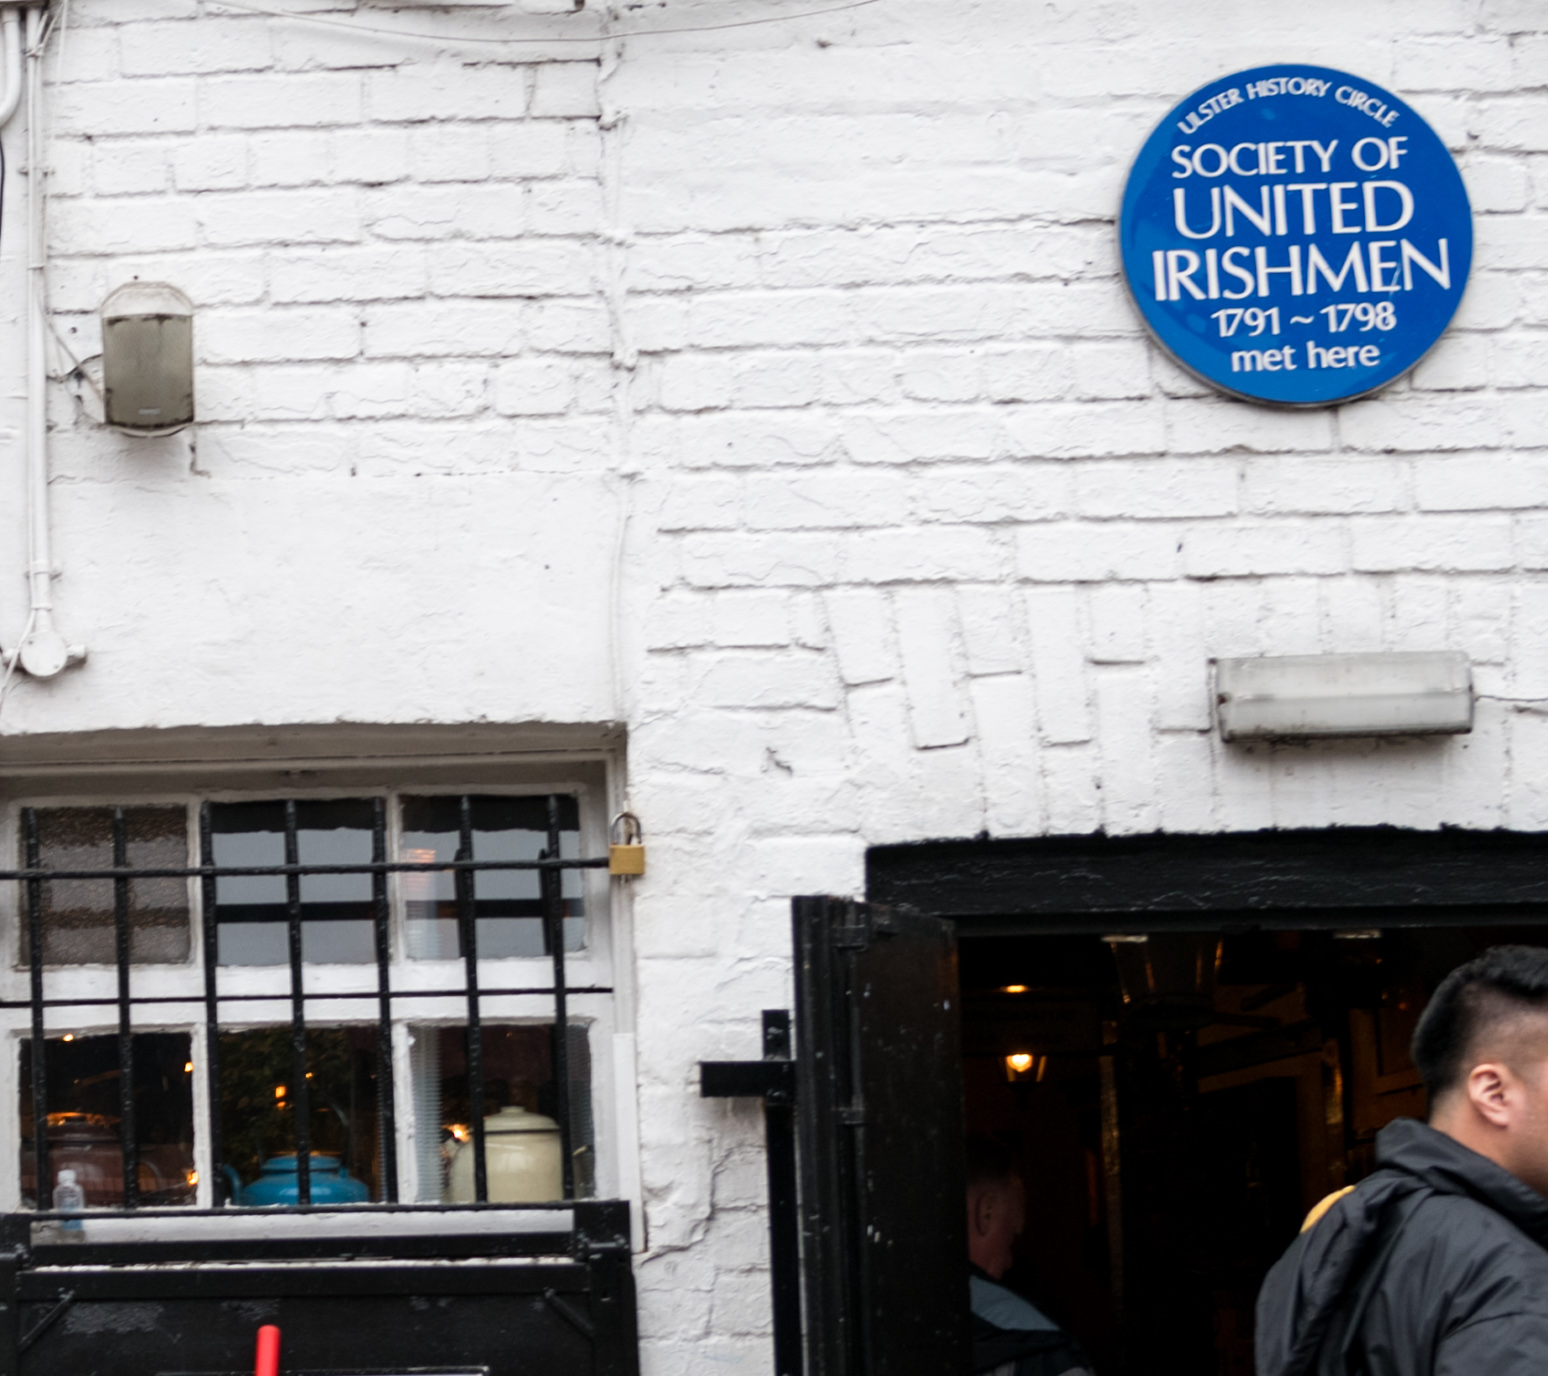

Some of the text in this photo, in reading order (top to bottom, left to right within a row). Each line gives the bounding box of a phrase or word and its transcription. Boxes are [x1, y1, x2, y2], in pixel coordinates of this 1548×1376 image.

[1178, 76, 1400, 135] ULSTER HISTORY CIRCLE
[1171, 136, 1408, 179] SOCIETY OF
[1173, 180, 1414, 240] UNITED
[1152, 238, 1451, 302] IRISHMEN
[1211, 307, 1280, 338] 1791
[1321, 301, 1397, 334] 1798
[1231, 340, 1380, 372] met here
